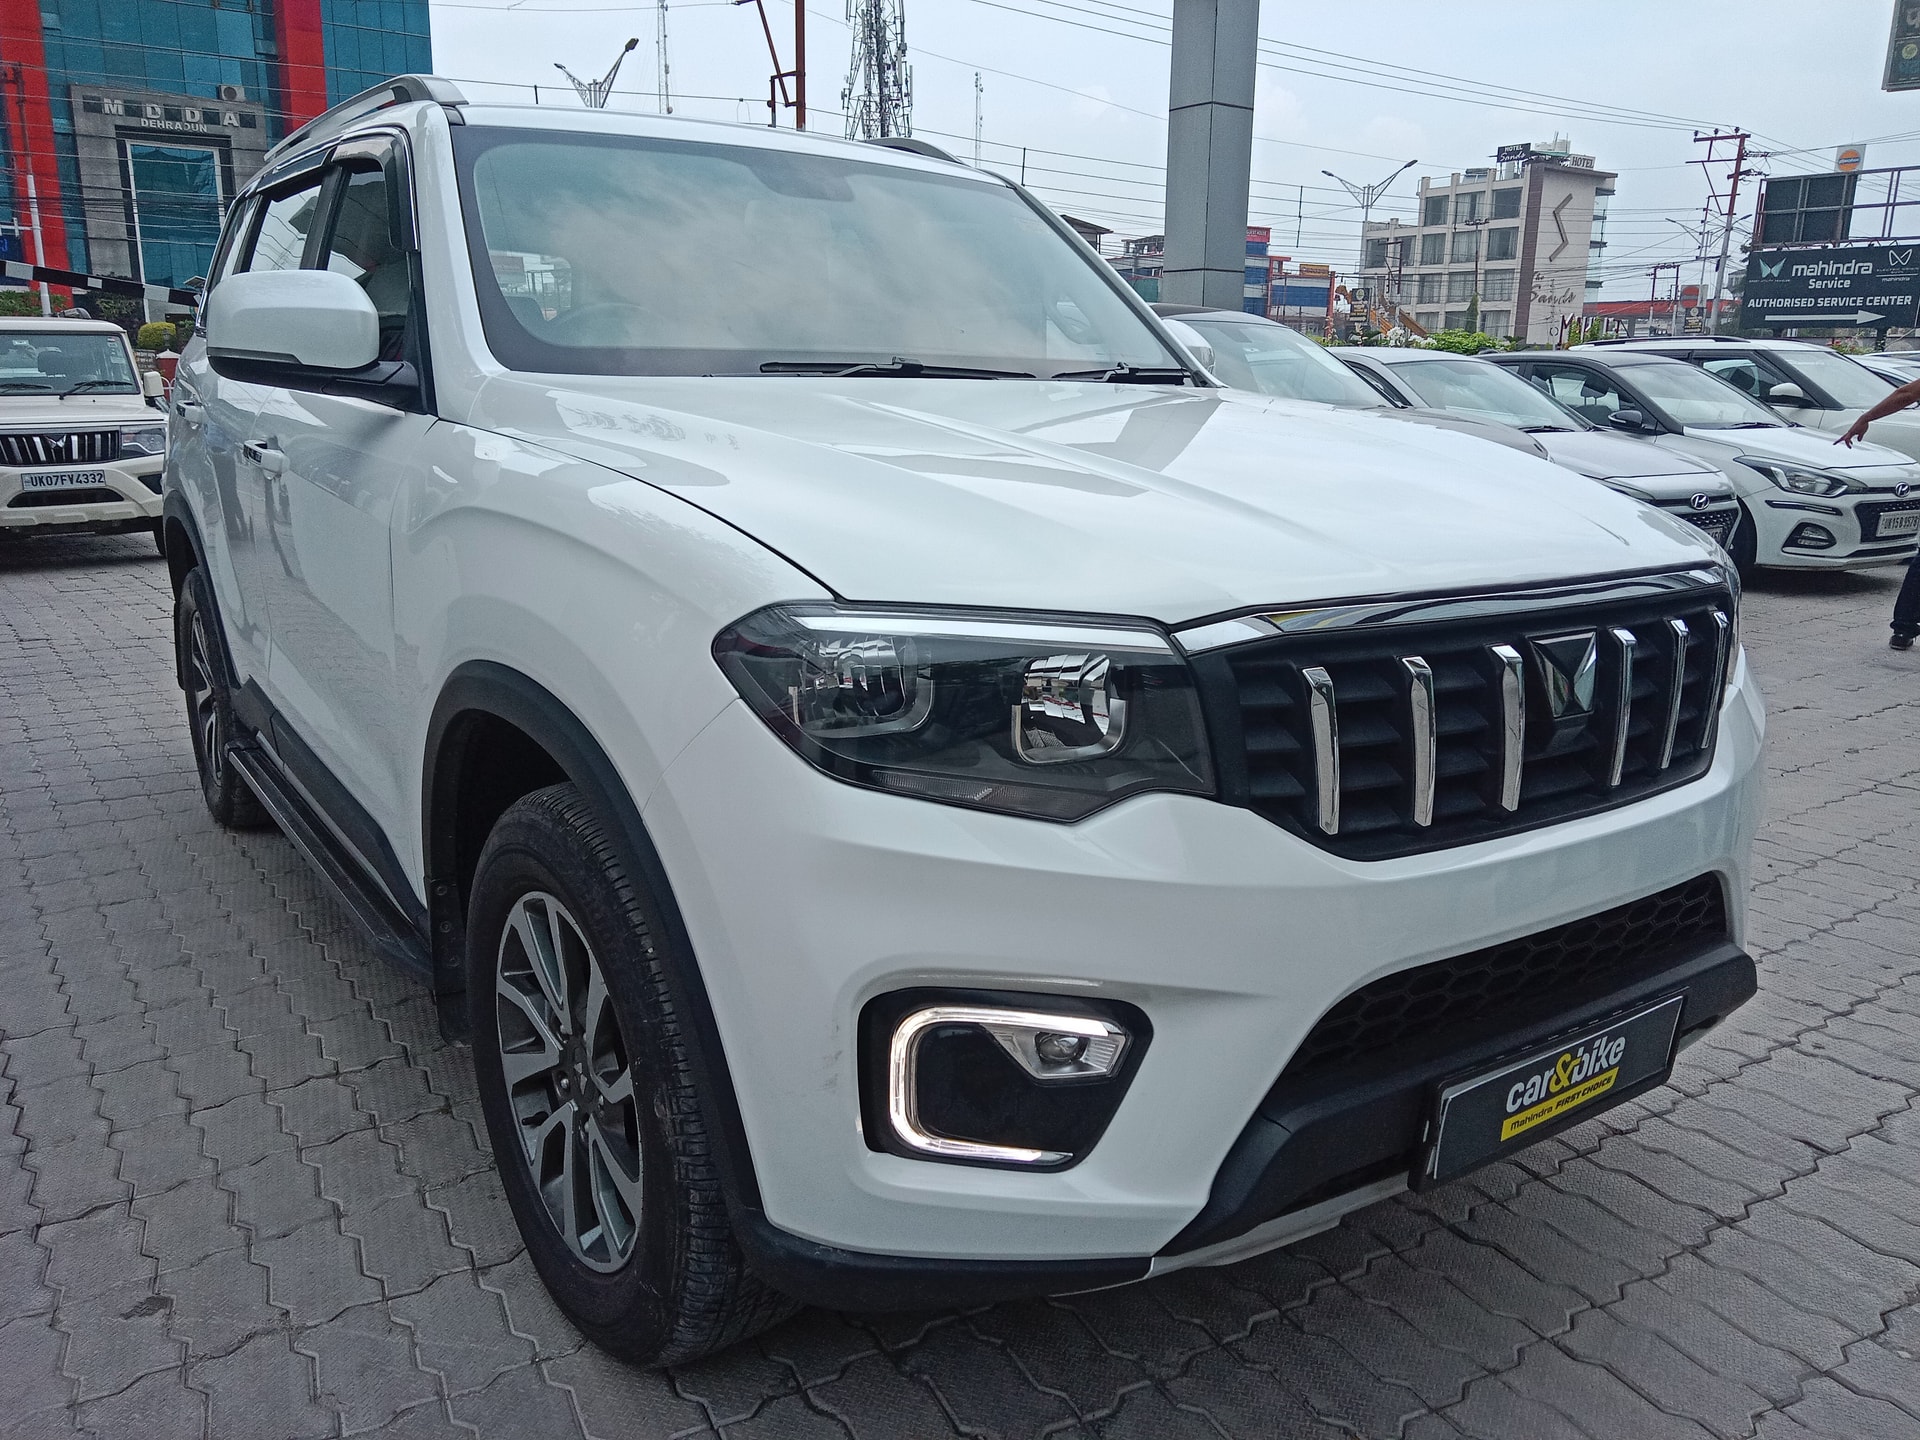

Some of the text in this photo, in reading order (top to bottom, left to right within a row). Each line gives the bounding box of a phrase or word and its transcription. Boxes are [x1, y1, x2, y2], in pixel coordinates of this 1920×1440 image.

[140, 118, 208, 133] DEHRADUN
[1500, 151, 1526, 162] Sands
[1571, 156, 1595, 169] HOTEL
[1791, 259, 1873, 277] mahindra
[1808, 277, 1851, 289] Service
[1530, 284, 1577, 305] Sands
[1748, 298, 1815, 308] AUTHORISED
[1816, 296, 1864, 307] SERVICE
[1866, 295, 1912, 306] CENTER
[30, 473, 104, 487] UK07FV4332
[1510, 1075, 1614, 1131] Mahindra FIRST CHOICE
